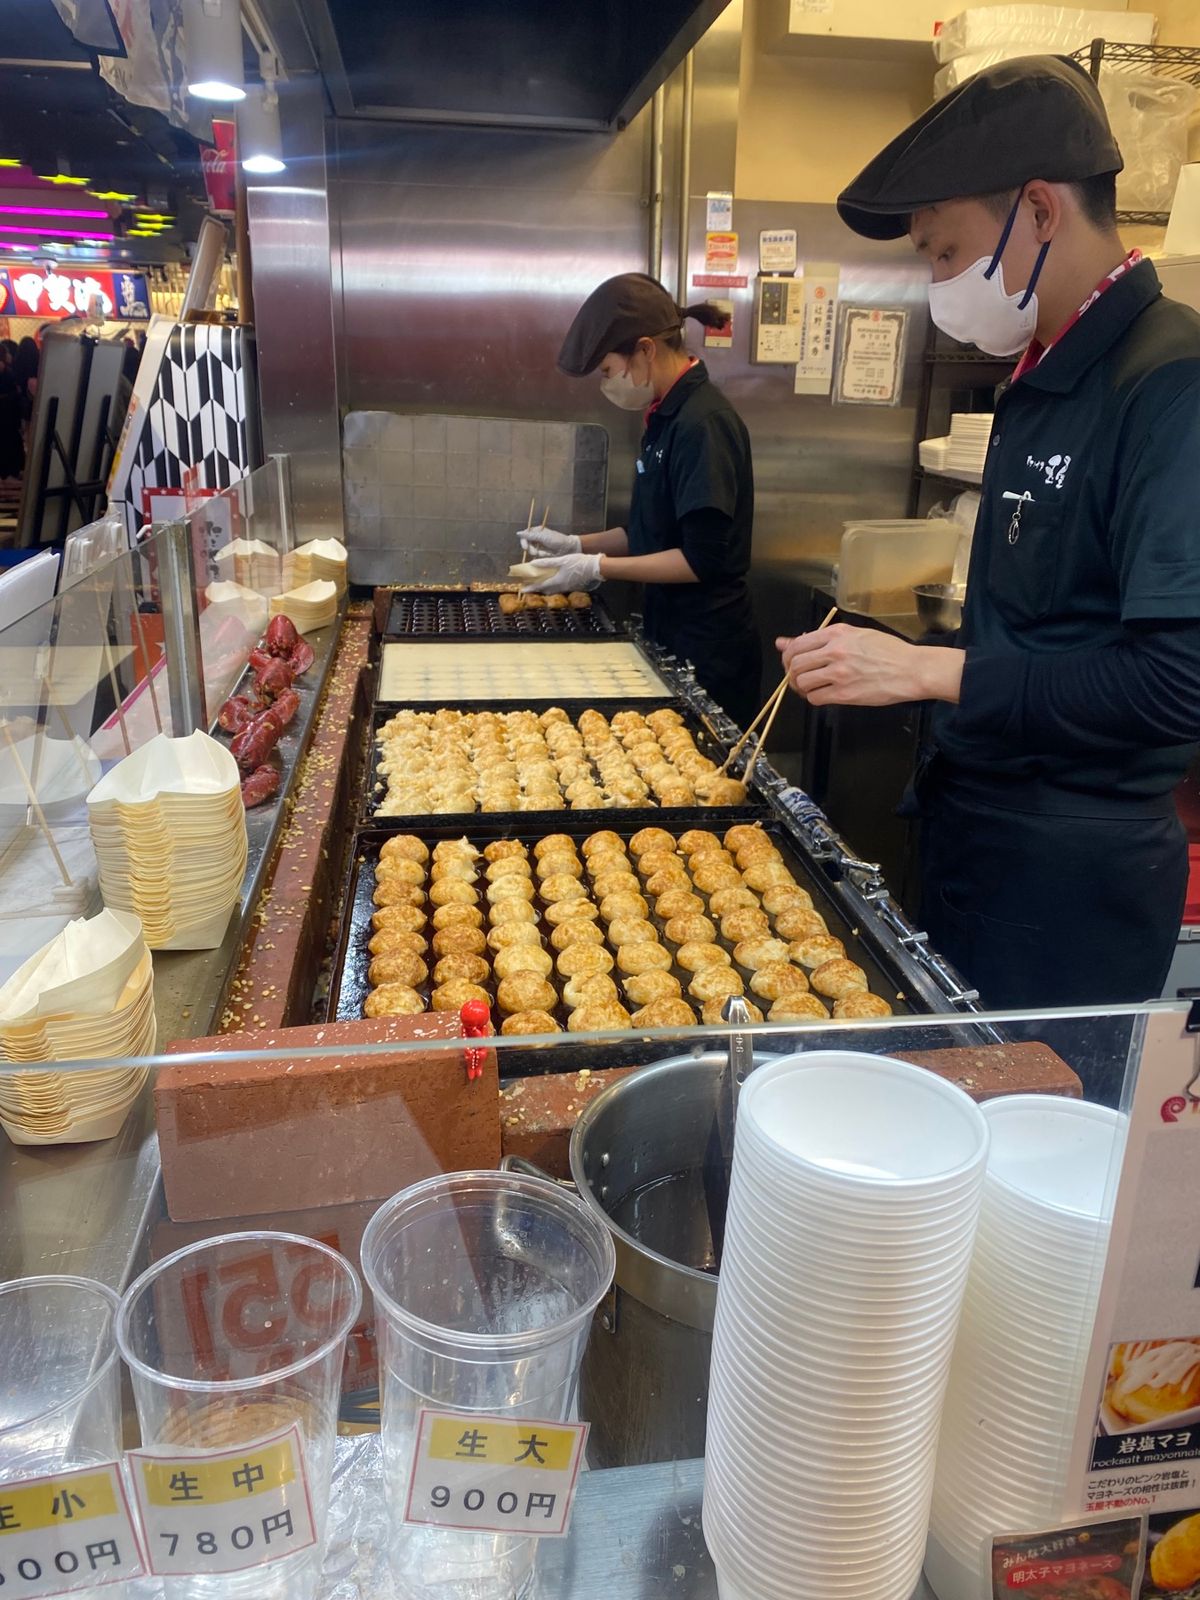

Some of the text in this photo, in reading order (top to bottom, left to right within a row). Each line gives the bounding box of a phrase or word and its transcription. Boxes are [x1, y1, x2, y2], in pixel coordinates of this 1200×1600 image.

[455, 1429, 548, 1464] 生 大
[1117, 1432, 1192, 1454] 岩塩マヨ
[1092, 1456, 1140, 1469] rocksalt
[169, 1463, 264, 1501] 生 中
[1088, 1470, 1190, 1489] こだわりのピンク岩塩と
[51, 1490, 86, 1518] 小
[430, 1485, 557, 1518] 900円
[160, 1509, 294, 1556] 780円
[0, 1539, 121, 1586] 00円
[1002, 1536, 1077, 1569] みんな大好き
[1012, 1556, 1114, 1585] 明太子マヨネーズ
